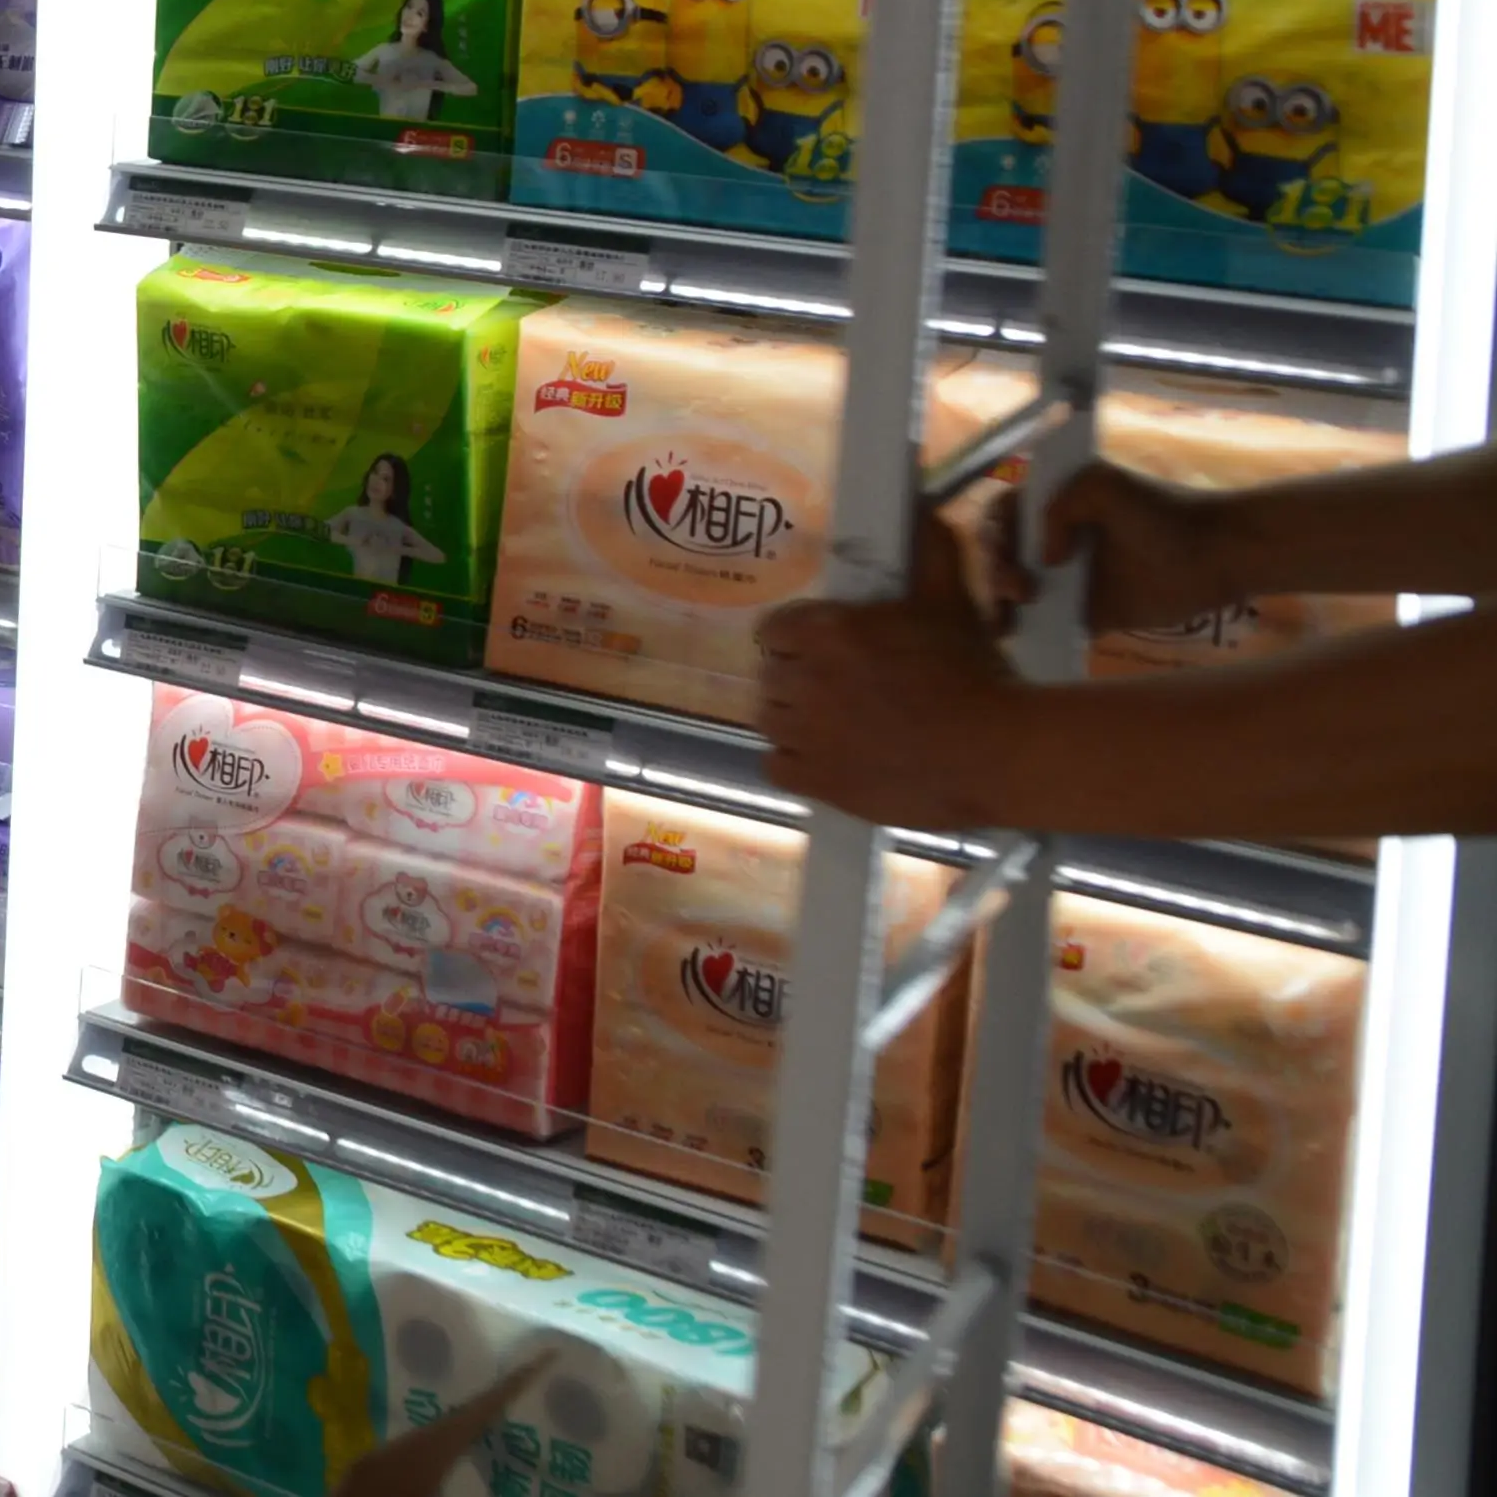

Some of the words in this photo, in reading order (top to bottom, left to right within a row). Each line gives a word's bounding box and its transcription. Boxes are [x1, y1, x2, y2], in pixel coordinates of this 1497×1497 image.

[1358, 8, 1416, 52] ME
[162, 319, 236, 365] 心相印
[559, 351, 615, 381] New
[624, 465, 794, 559] 心相印
[172, 734, 270, 797] 心相印
